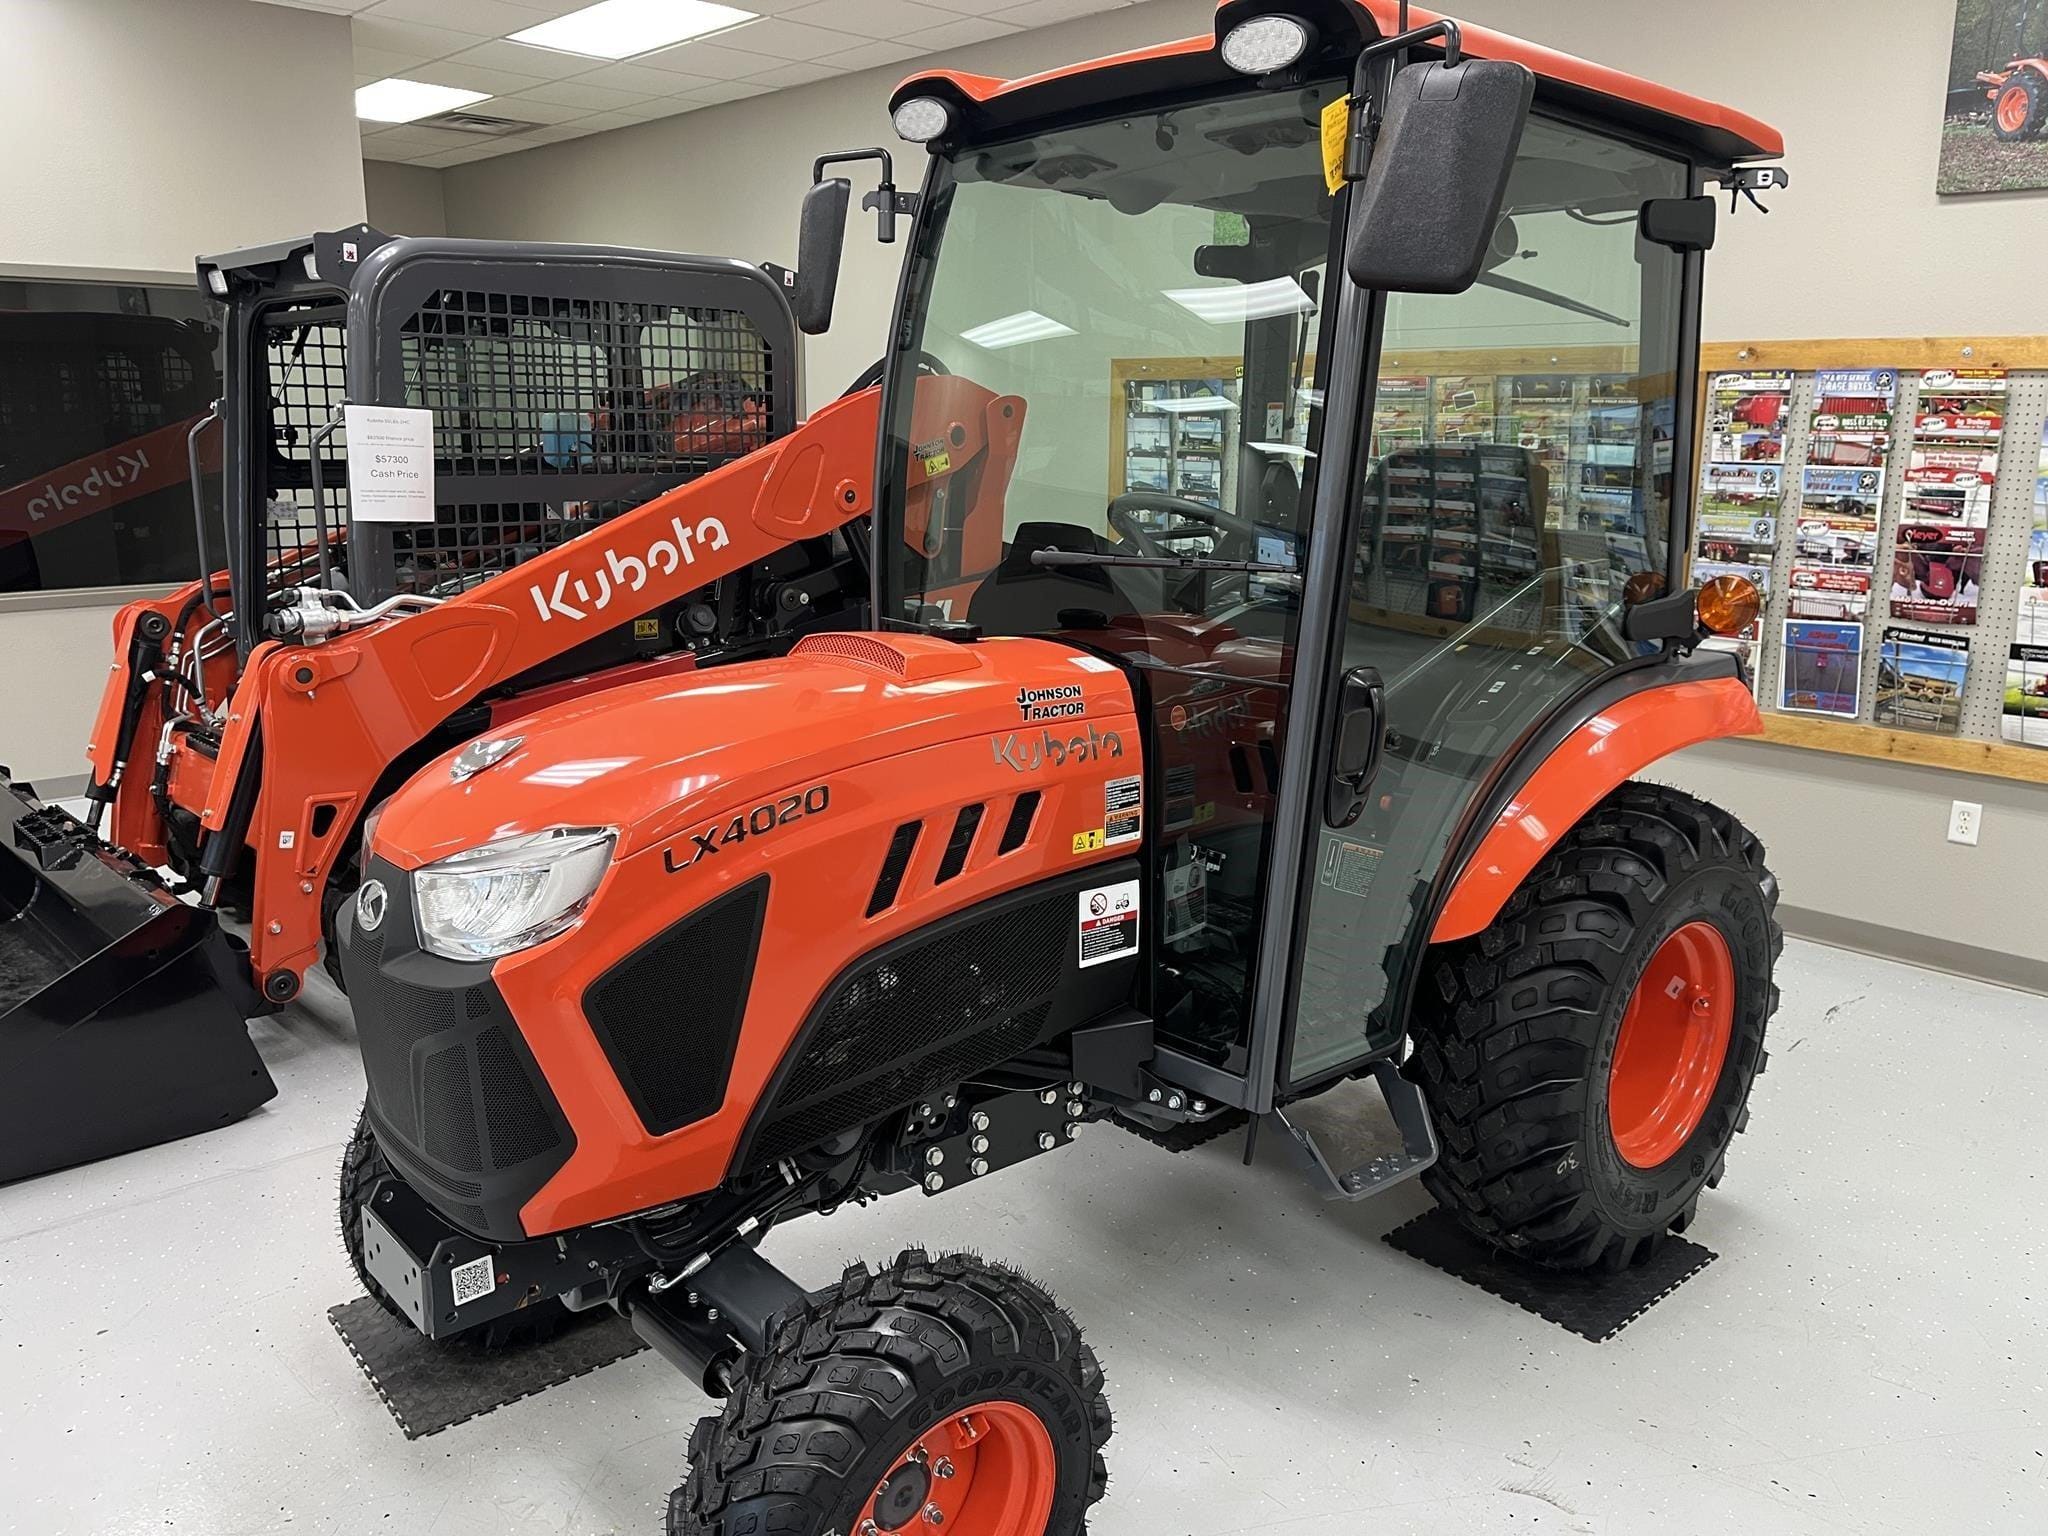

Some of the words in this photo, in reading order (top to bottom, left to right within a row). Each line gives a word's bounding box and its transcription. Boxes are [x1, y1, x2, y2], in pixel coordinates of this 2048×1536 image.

[375, 454, 409, 464] $57300
[370, 469, 395, 478] Cash
[397, 470, 419, 479] Price
[530, 517, 730, 622] Kubota
[1016, 685, 1082, 704] JOHNSON
[1020, 702, 1085, 721] TRACTOR
[991, 723, 1123, 772] Kubota
[1113, 809, 1139, 821] WARNING
[663, 784, 830, 874] LX4020
[1102, 914, 1125, 925] DANGER
[908, 1367, 1083, 1436] GOODYEAR
